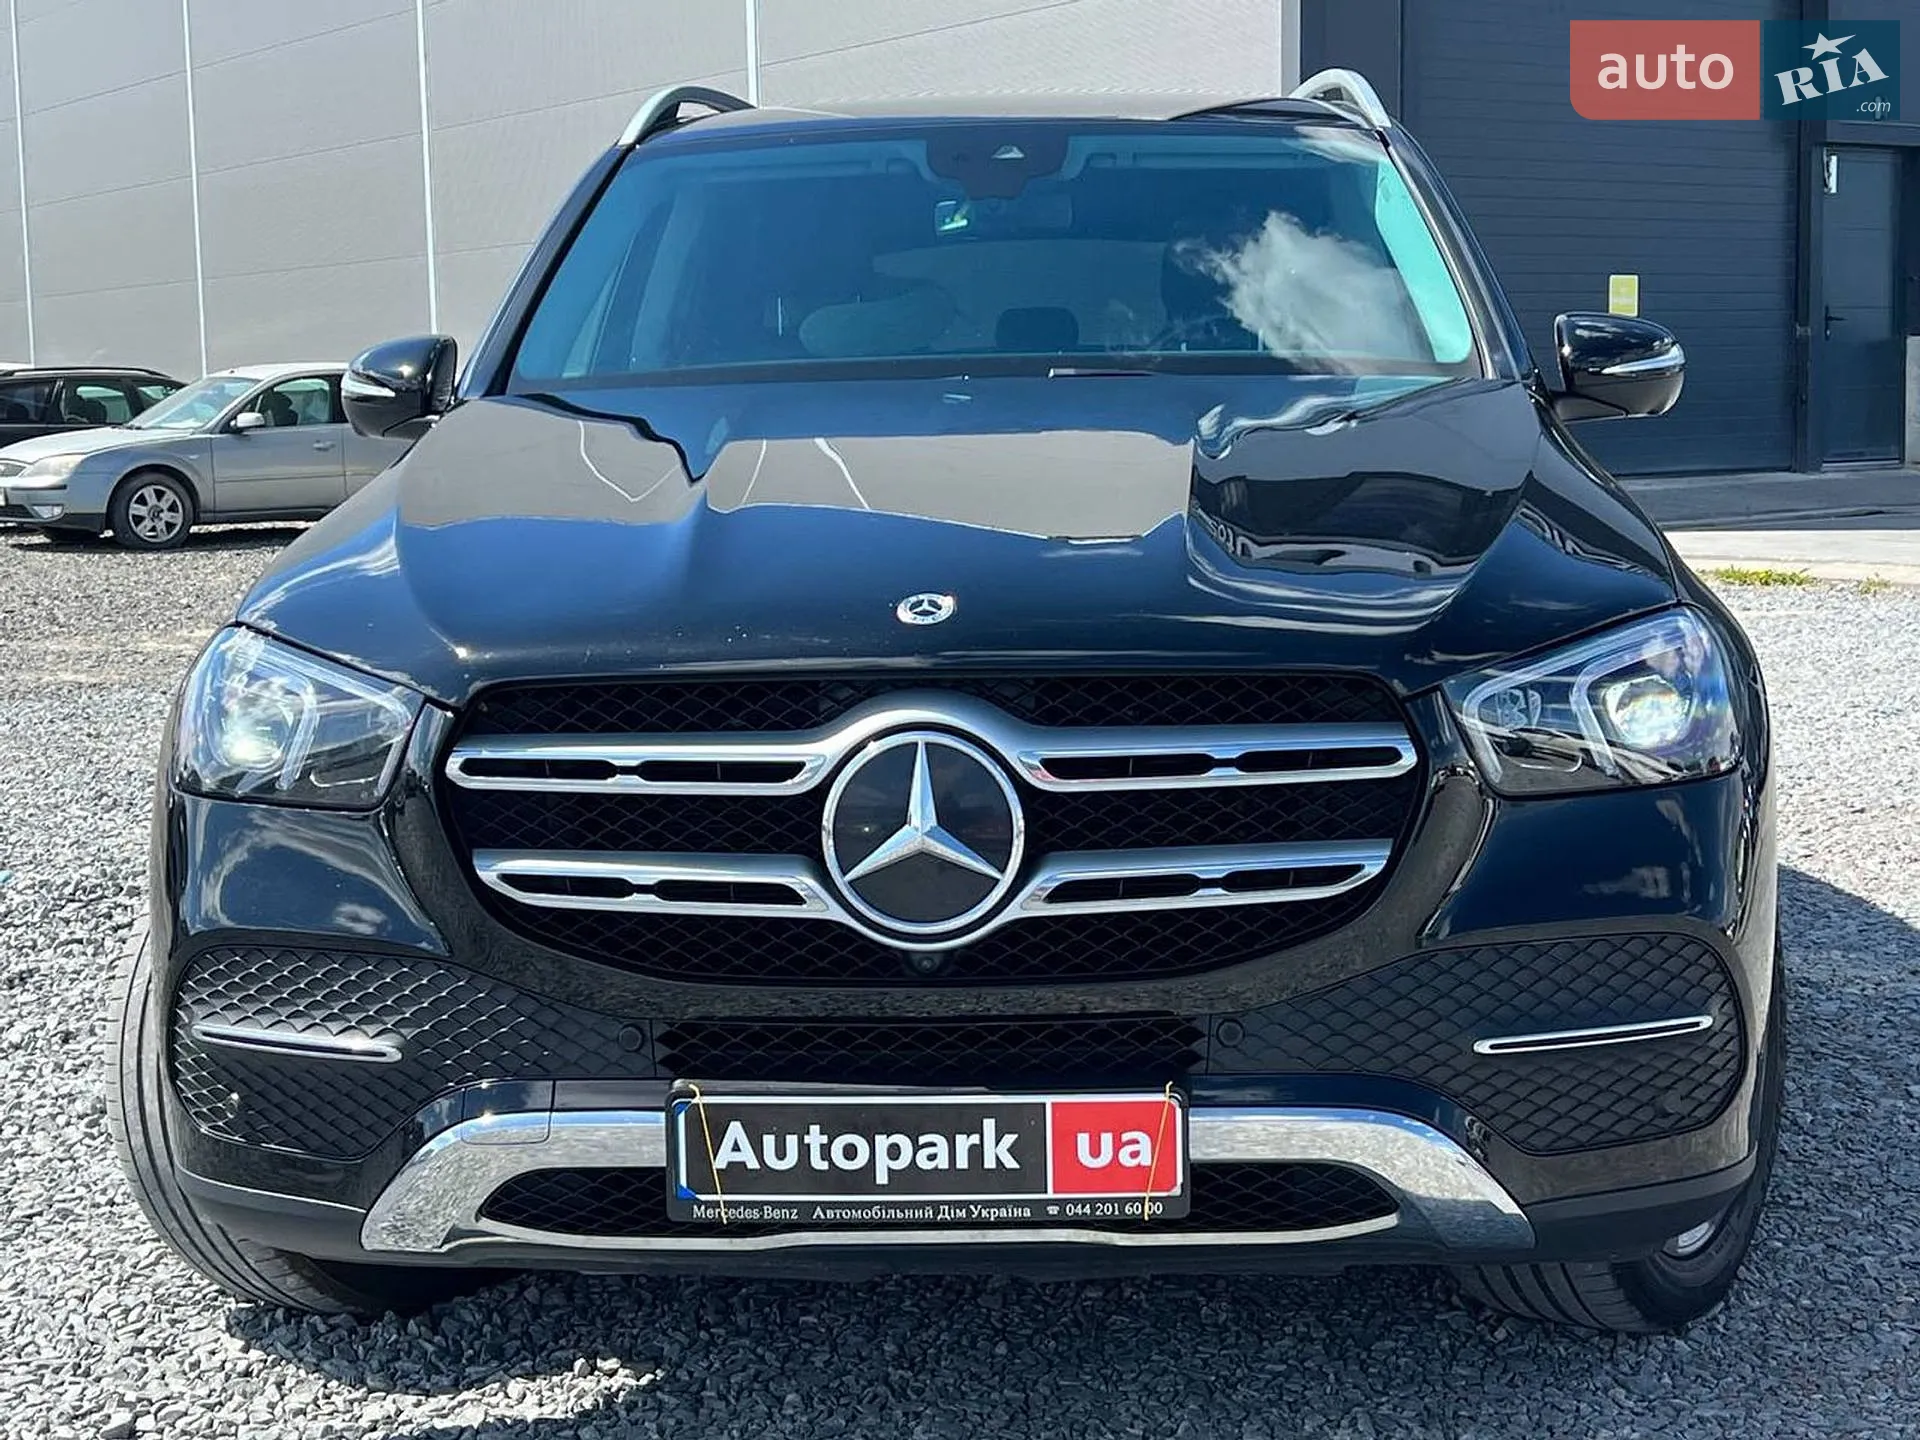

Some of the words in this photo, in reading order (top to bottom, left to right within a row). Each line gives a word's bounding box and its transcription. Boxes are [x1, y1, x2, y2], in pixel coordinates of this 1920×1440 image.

[714, 1118, 1020, 1185] Autopark
[1076, 1131, 1152, 1168] ua
[693, 1204, 799, 1220] Mercedes-Benz
[812, 1205, 934, 1220] Автомобільний
[937, 1204, 966, 1221] Дім
[969, 1204, 1032, 1221] Україна
[1065, 1203, 1091, 1216] 044
[1095, 1203, 1120, 1215] 201
[1124, 1202, 1142, 1215] 60
